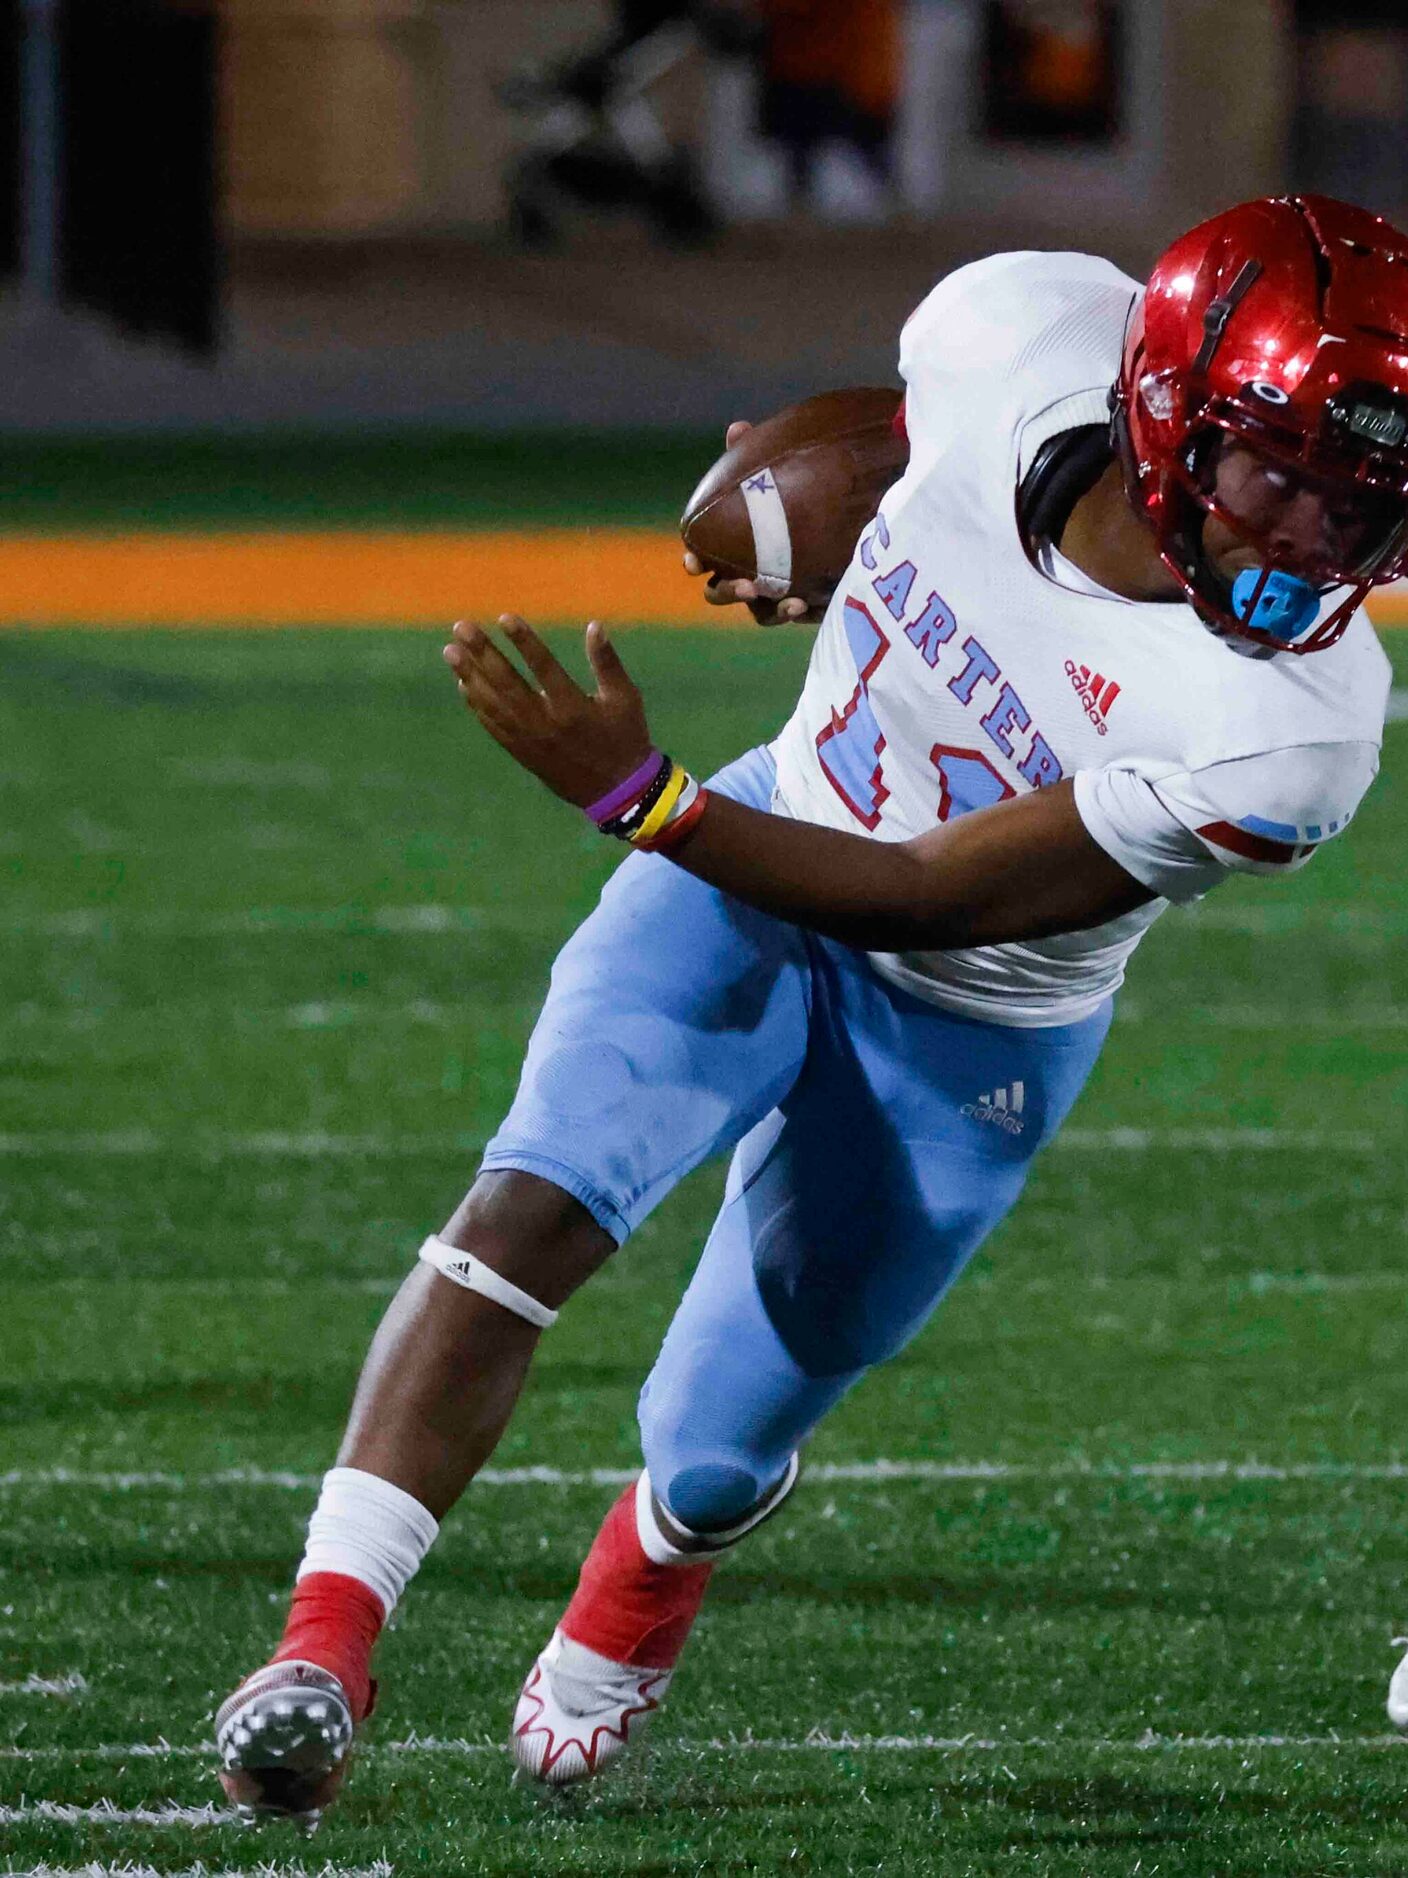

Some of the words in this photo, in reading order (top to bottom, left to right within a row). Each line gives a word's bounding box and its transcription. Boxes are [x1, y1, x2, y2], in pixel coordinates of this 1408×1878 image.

[859, 511, 1064, 788] CARTER
[1063, 659, 1108, 736] adidas
[960, 1103, 1024, 1135] adidas
